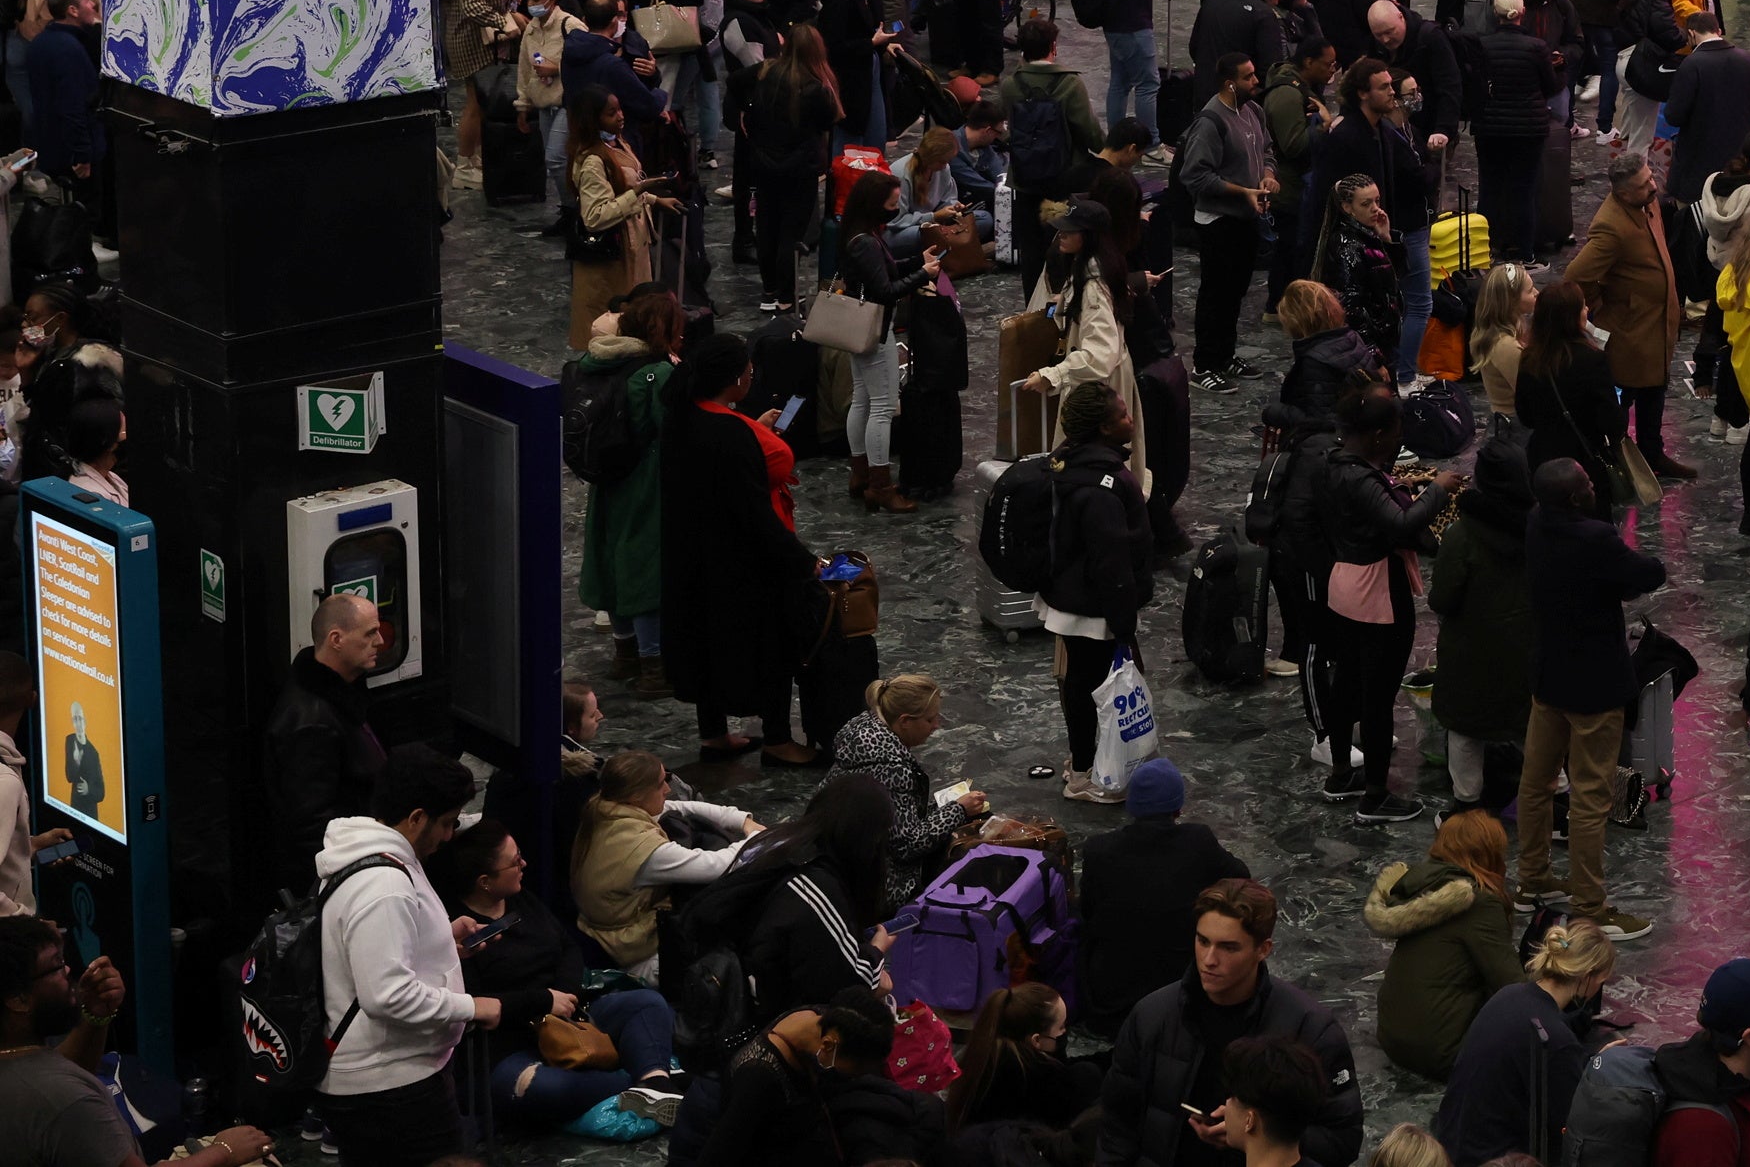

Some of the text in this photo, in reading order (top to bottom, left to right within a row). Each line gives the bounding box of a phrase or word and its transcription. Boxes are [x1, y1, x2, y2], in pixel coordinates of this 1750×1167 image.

[313, 436, 363, 449] Defibrillator
[38, 529, 99, 568] Avanti West Coast,
[39, 547, 99, 586] LNER, ScotRail and
[39, 566, 91, 601] The Caledonian
[40, 586, 112, 629] Sleeper are advised to
[42, 606, 112, 648] check for more details
[42, 627, 86, 655] on services at
[43, 645, 115, 688] www.nationalrail.co.uk
